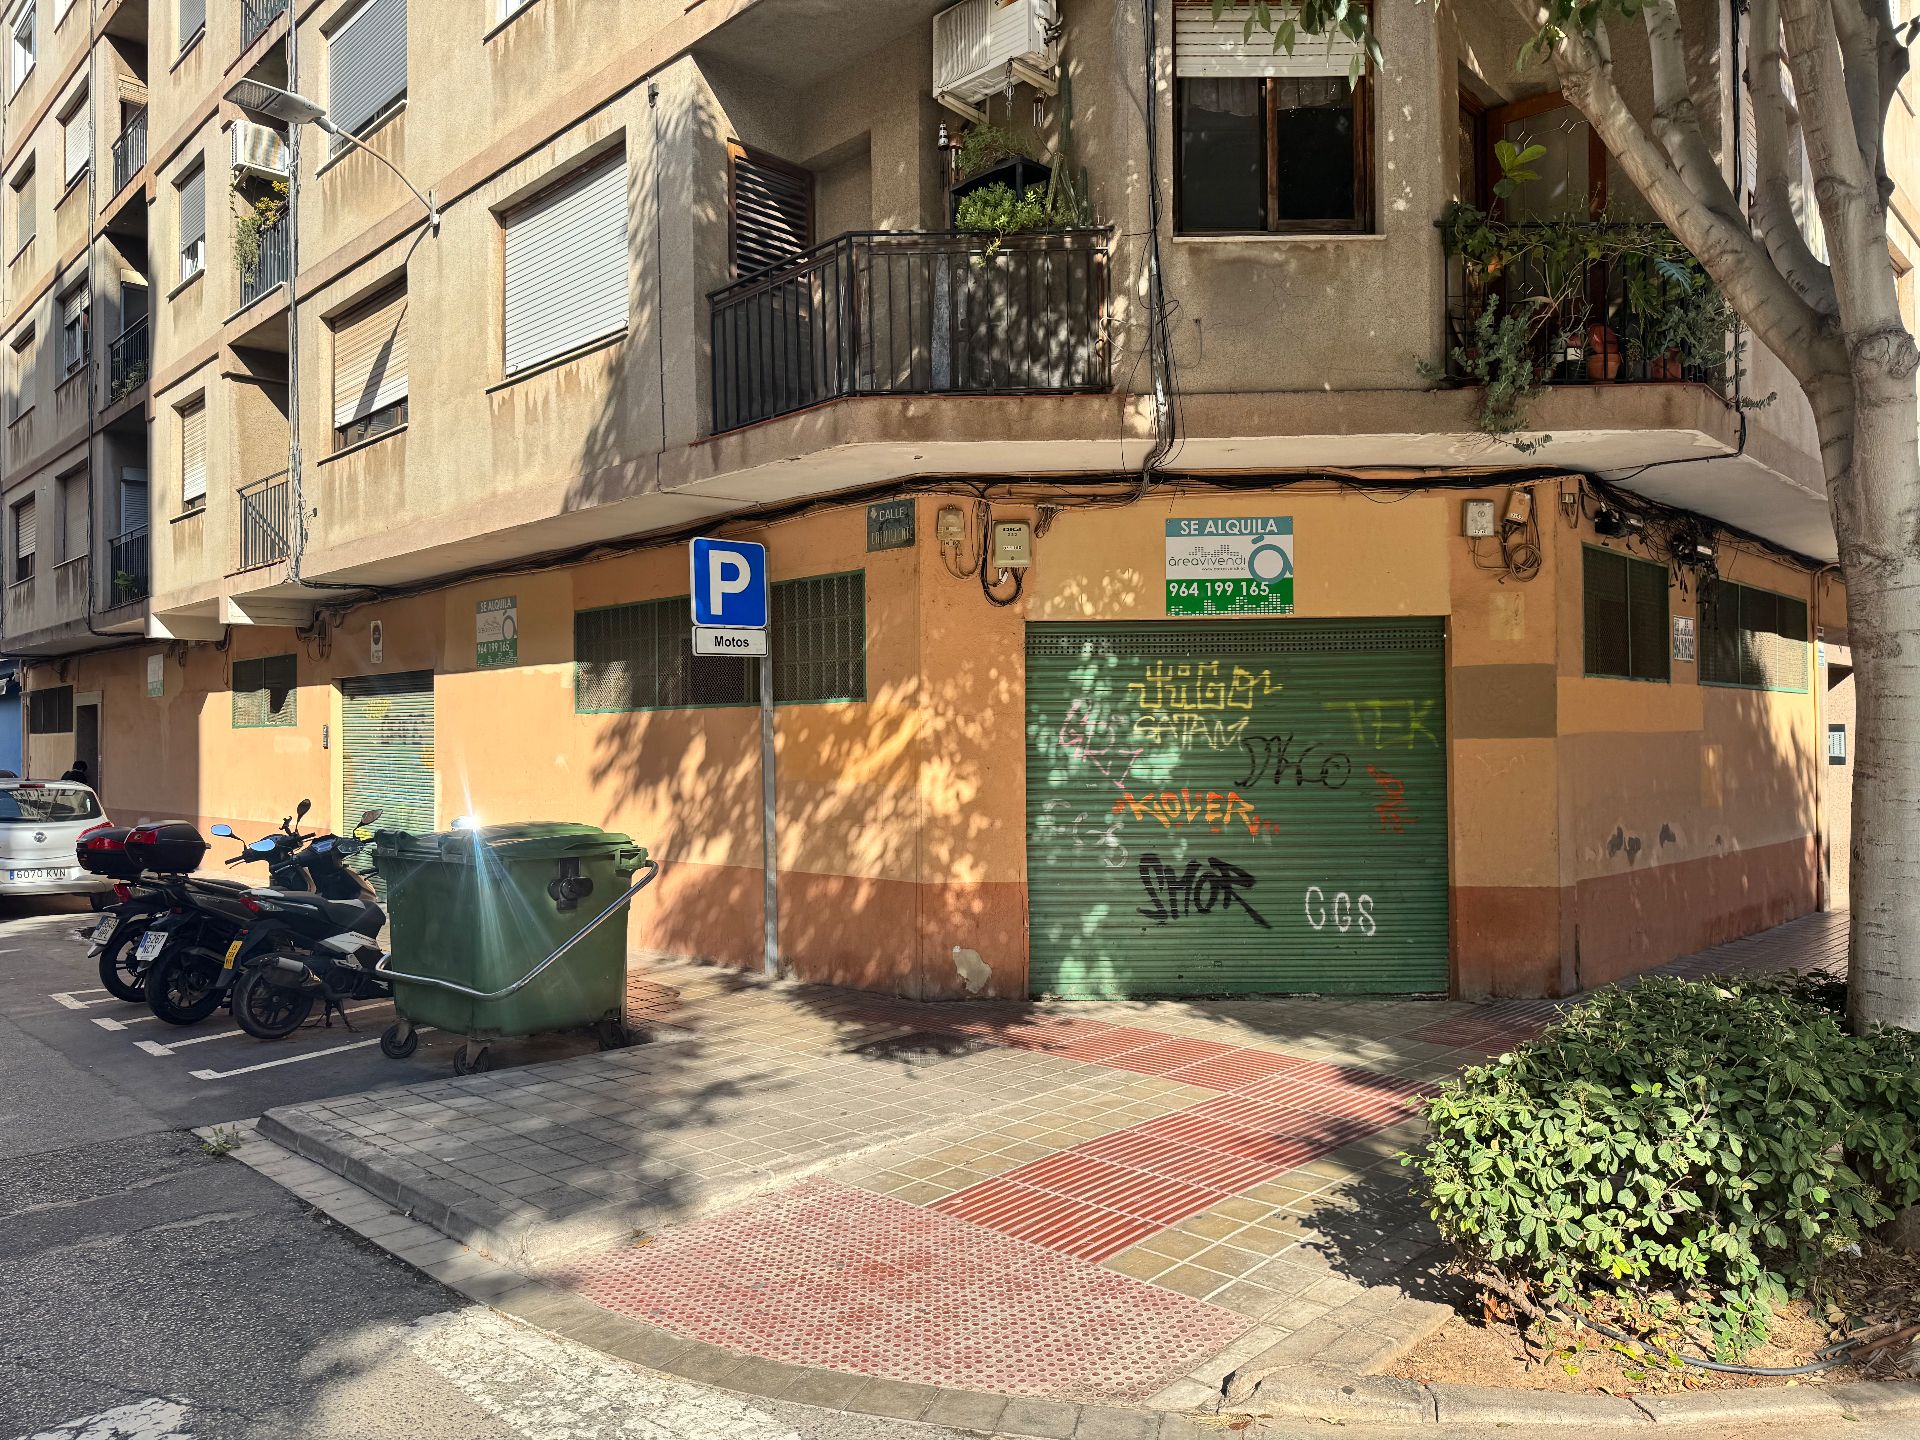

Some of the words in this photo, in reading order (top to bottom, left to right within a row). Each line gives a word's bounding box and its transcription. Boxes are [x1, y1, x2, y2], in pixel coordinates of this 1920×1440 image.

[880, 507, 905, 521] CALLE
[1180, 520, 1199, 535] SE
[1203, 518, 1278, 535] ALQUILA
[708, 549, 751, 616] P
[1169, 581, 1200, 597] 964
[1205, 581, 1234, 597] 199
[1240, 581, 1270, 596] 165
[480, 601, 487, 612] SE
[487, 597, 512, 611] ALQUILA
[714, 635, 750, 648] Motos
[16, 869, 43, 879] 6070
